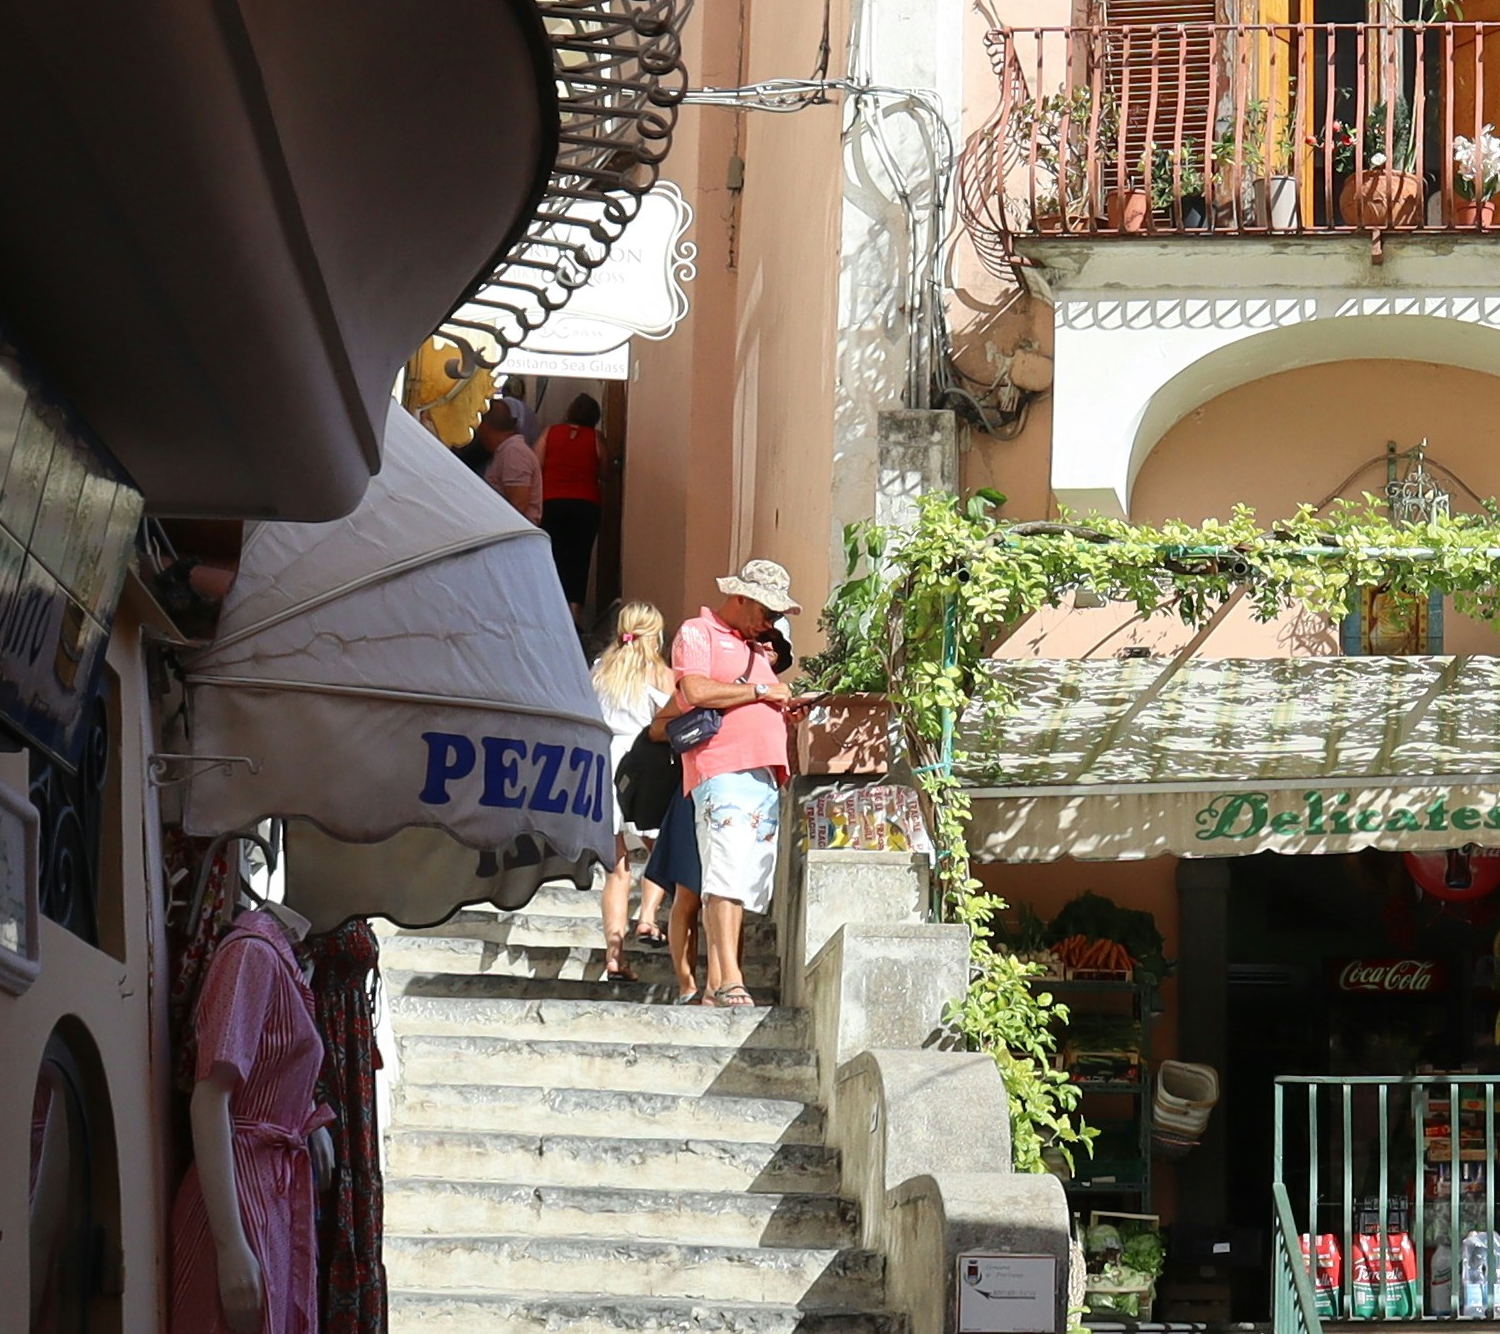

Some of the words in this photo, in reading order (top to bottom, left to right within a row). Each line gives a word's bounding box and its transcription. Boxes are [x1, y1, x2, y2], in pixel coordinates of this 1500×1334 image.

[506, 357, 558, 372] ositano
[562, 359, 587, 372] Sea
[589, 360, 625, 374] Glass
[1339, 960, 1437, 991] Coca-Cola
